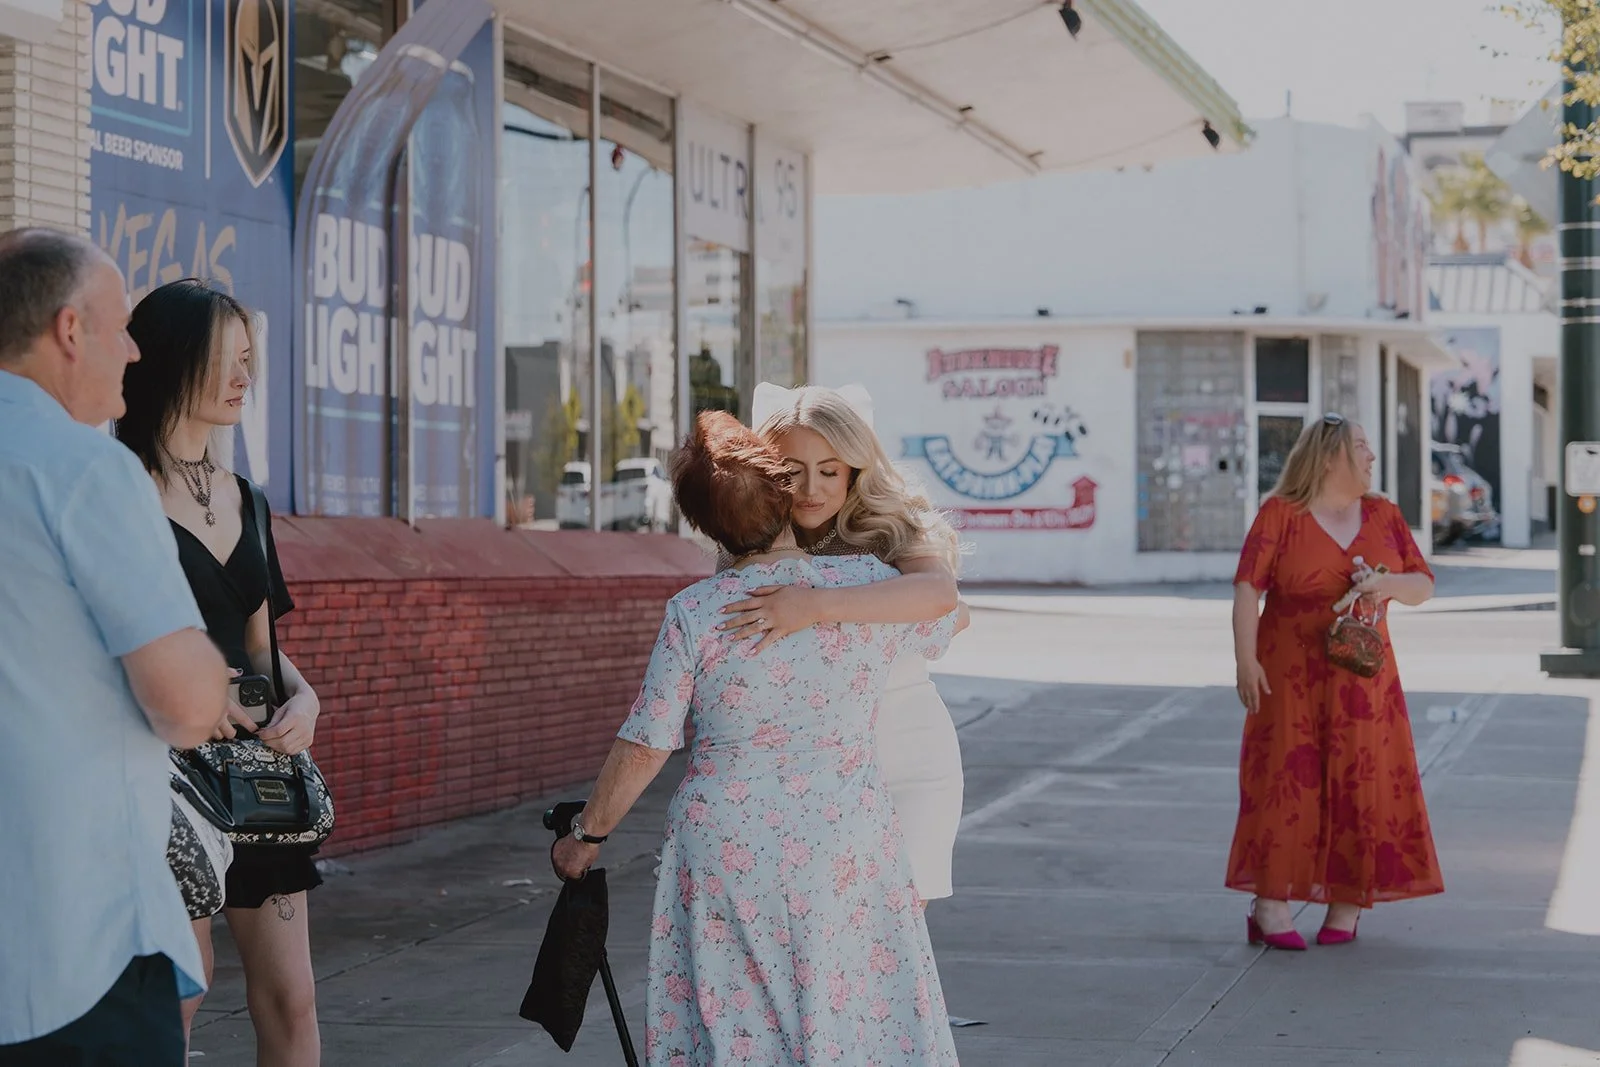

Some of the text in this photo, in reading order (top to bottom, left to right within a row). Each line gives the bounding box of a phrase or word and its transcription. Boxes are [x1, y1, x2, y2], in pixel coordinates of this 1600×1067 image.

[89, 15, 184, 111] GHT
[104, 132, 132, 158] BEER
[133, 140, 184, 171] SPONSOR
[688, 141, 764, 226] ULTR
[100, 202, 236, 306] VEGAS
[314, 213, 388, 308] BUD
[411, 320, 477, 408] GHT
